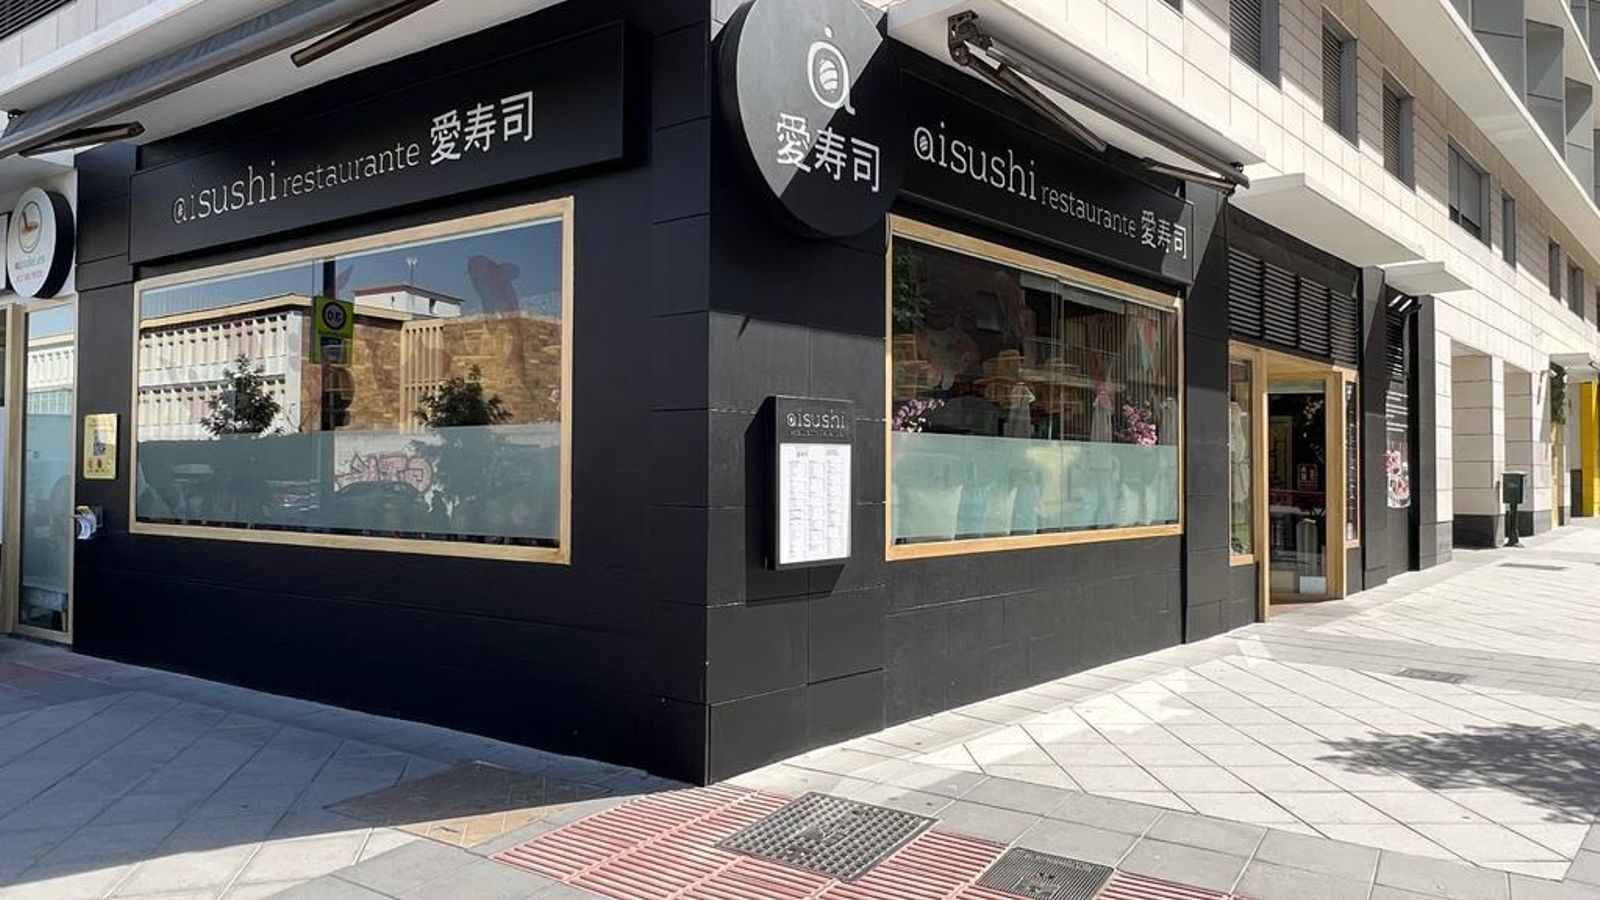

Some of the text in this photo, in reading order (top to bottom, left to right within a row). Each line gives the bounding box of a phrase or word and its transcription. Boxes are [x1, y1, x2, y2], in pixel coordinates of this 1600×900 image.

[282, 141, 421, 198] restaurante
[430, 90, 534, 166] 愛寿司
[776, 112, 880, 193] 愛寿司
[1041, 185, 1137, 239] restaurante
[1141, 210, 1187, 260] 愛寿司
